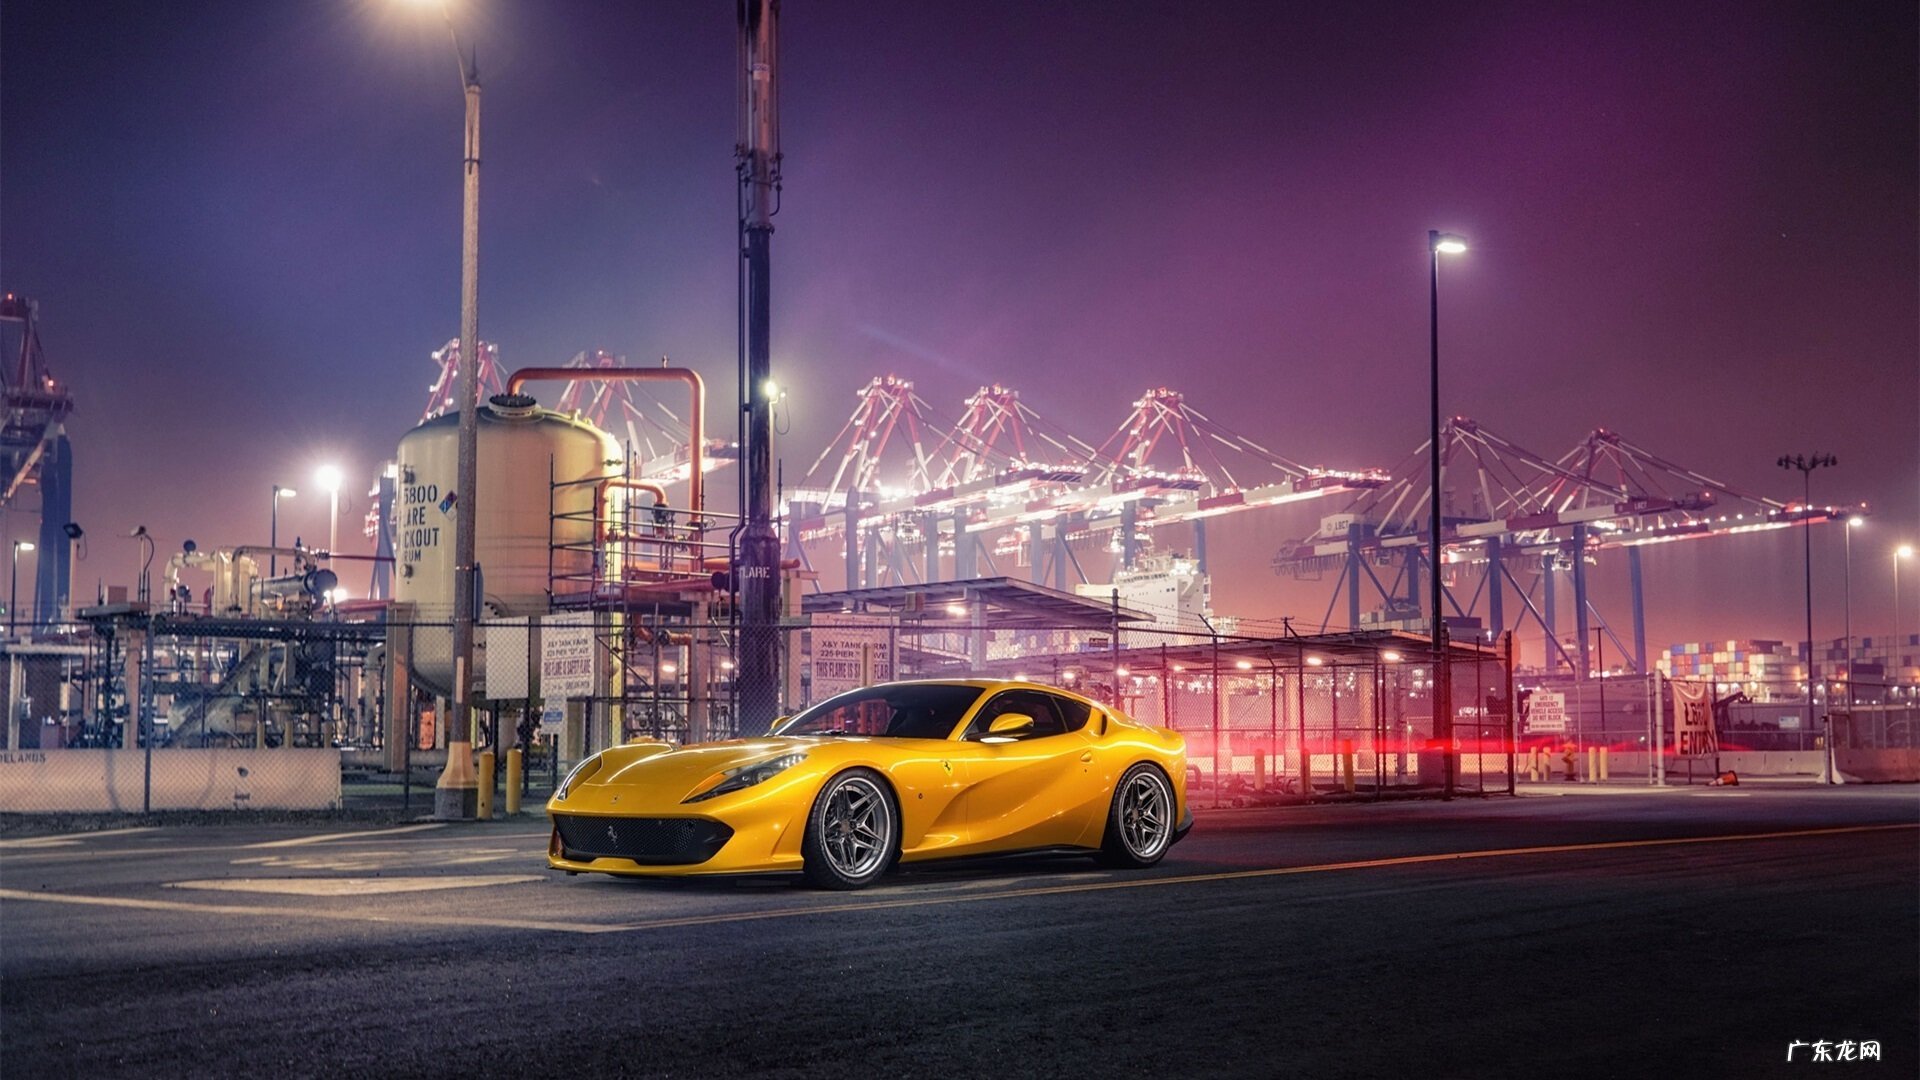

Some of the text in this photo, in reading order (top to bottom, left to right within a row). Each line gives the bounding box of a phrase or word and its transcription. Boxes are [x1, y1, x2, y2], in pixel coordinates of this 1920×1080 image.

[821, 650, 833, 658] 225
[835, 650, 854, 658] PIER
[816, 662, 828, 678] THIS
[829, 662, 846, 678] FLAME
[1680, 730, 1716, 755] ENTRY
